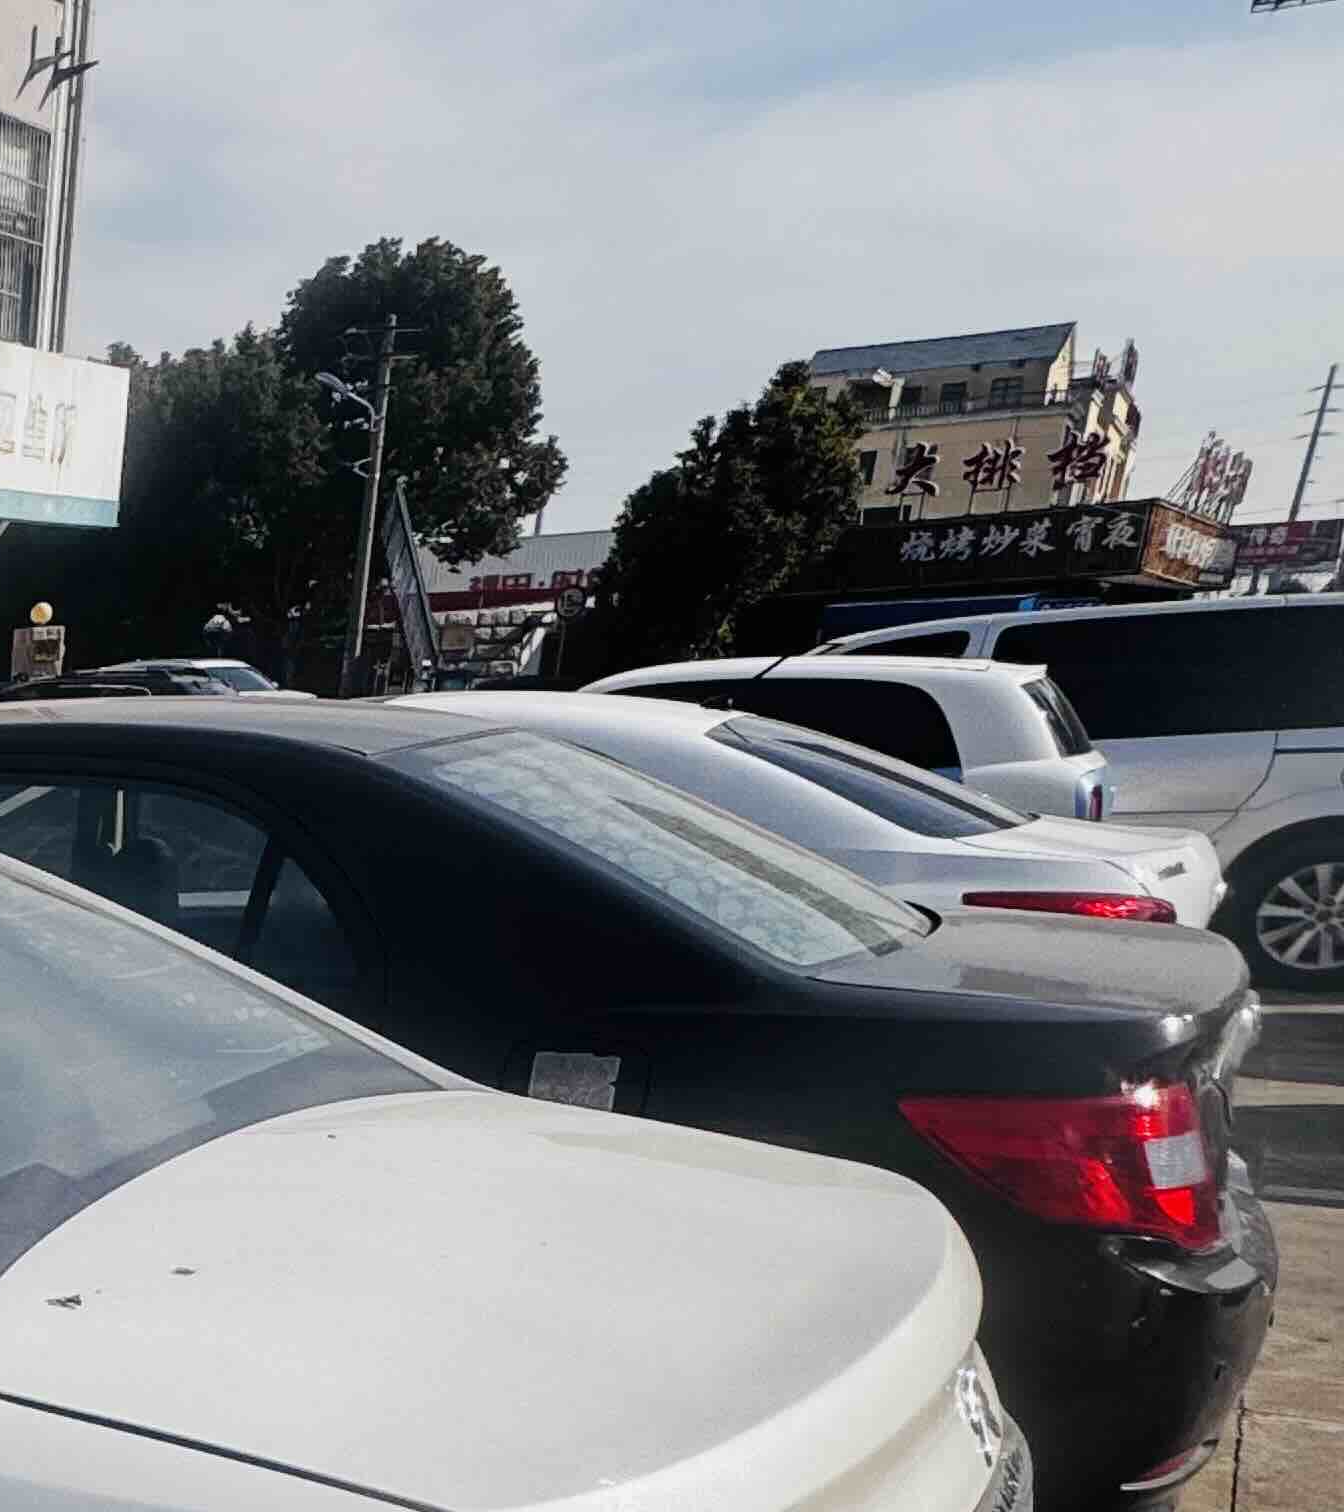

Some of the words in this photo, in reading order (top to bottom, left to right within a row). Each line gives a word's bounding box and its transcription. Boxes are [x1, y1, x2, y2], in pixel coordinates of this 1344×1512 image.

[884, 426, 1110, 496] 大排档
[900, 518, 1055, 562] 烧烤炒菜
[1066, 512, 1137, 552] 宵夜
